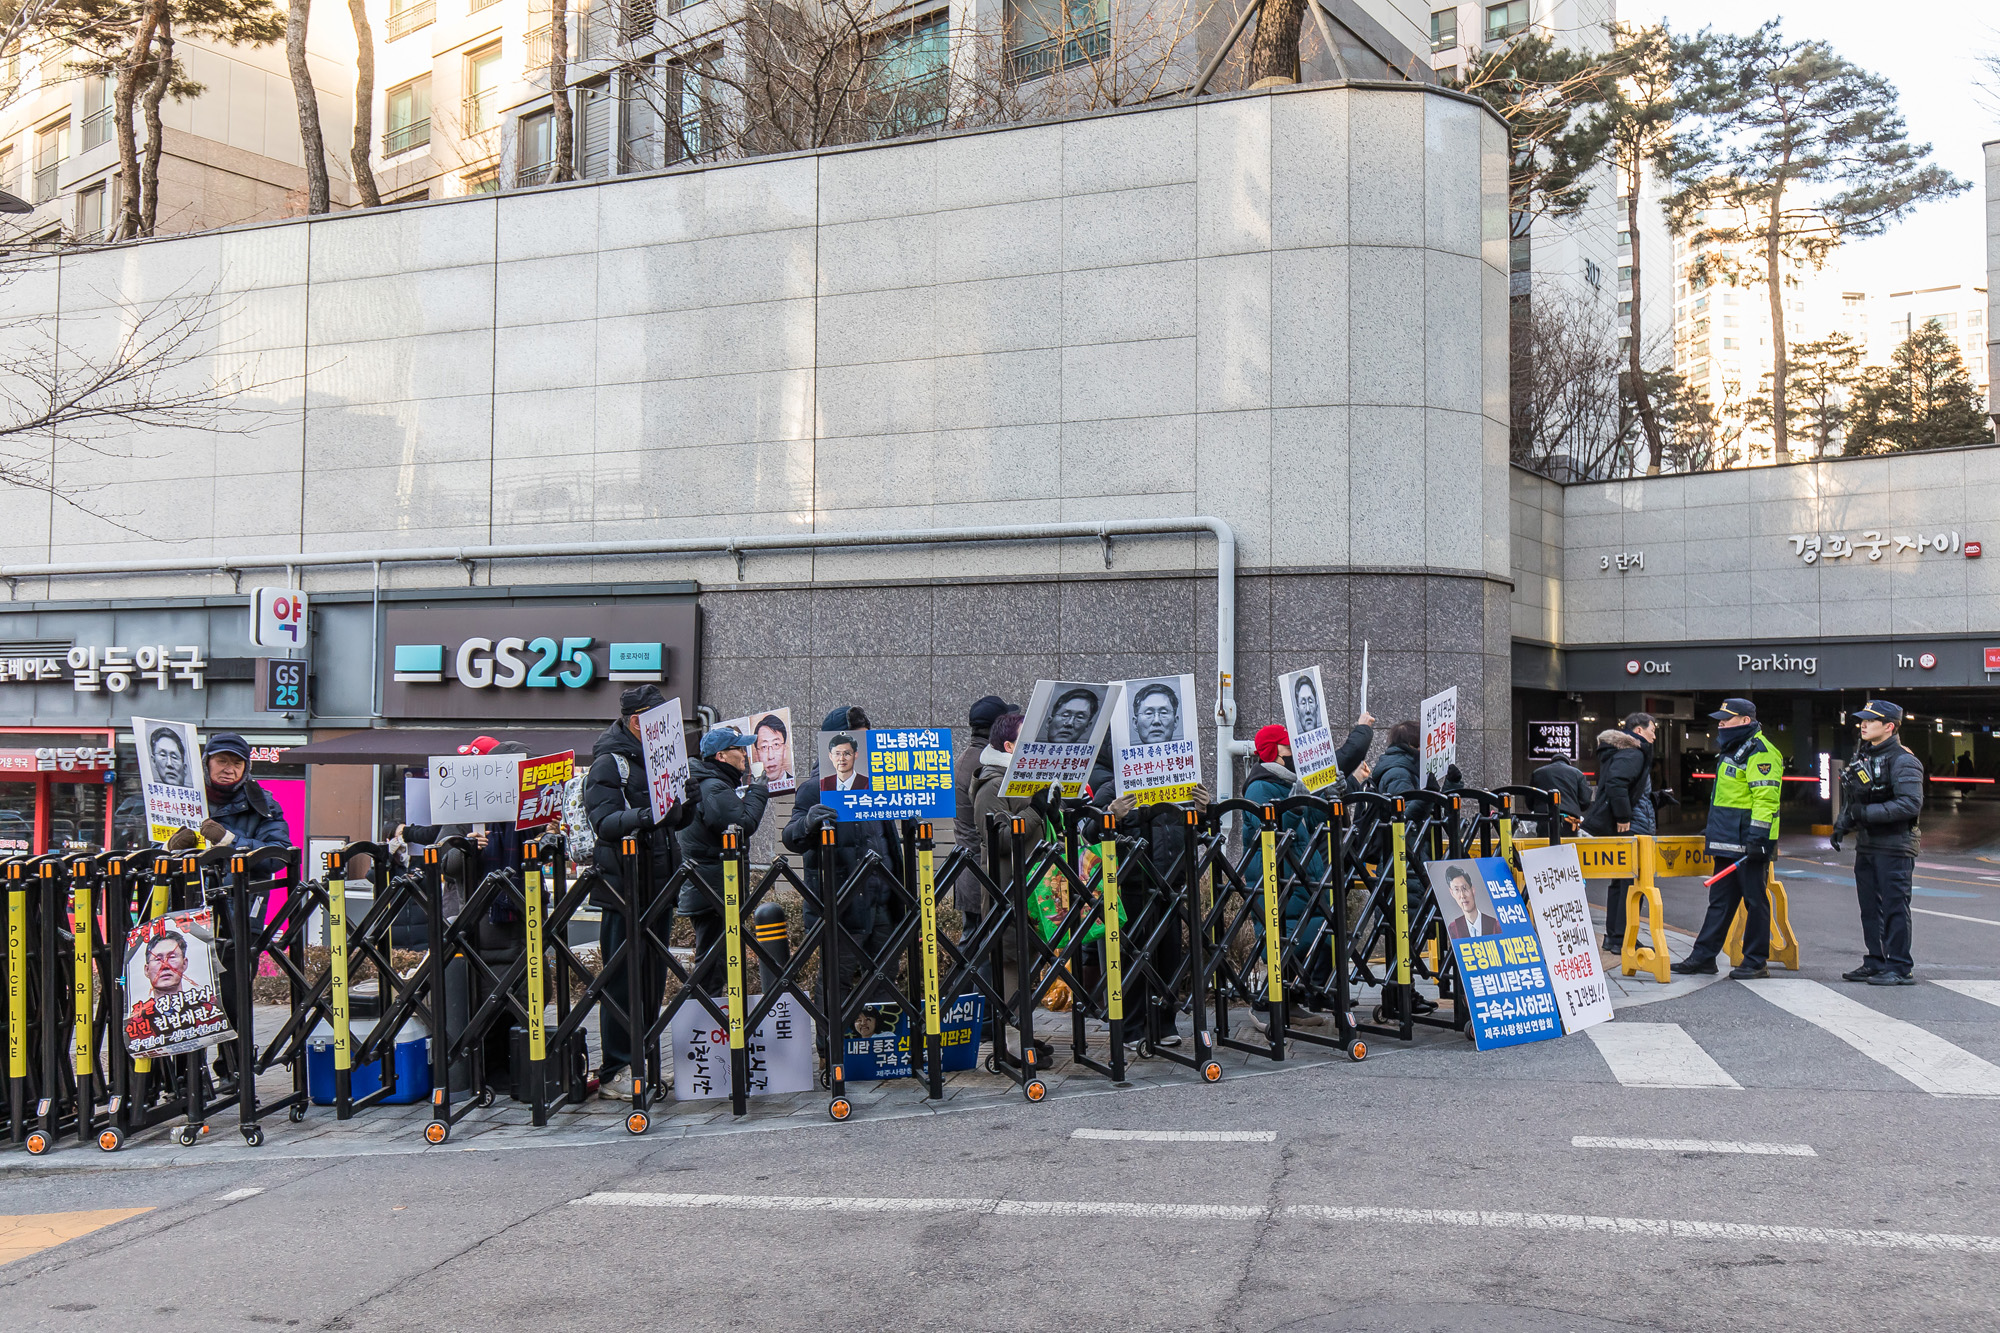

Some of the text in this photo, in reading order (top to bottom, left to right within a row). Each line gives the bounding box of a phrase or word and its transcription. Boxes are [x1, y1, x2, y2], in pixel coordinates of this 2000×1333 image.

[1584, 257, 1601, 290] 302
[1788, 530, 1960, 564] 경희궁자이
[1600, 551, 1645, 571] 3 단지
[273, 594, 302, 643] 약
[456, 637, 594, 689] GS25
[619, 652, 650, 661] 종로자이점
[1644, 660, 1671, 674] Out
[1737, 653, 1818, 675] Parking
[1897, 653, 1914, 668] In
[67, 644, 207, 692] 일등약국
[276, 664, 299, 685] GS
[276, 685, 299, 707] 25
[875, 731, 940, 749] 민노총하수인
[1539, 725, 1571, 736] 상가전용
[1022, 743, 1096, 756] 편파적 졸속 탄핵심리
[1121, 740, 1193, 761] 편파적 졸속 탄핵심리
[1547, 737, 1571, 747] 주차장
[35, 746, 117, 772] 일등약국
[250, 747, 290, 763] 소모성
[870, 750, 951, 773] 문형배 재판관
[521, 758, 574, 792] 탄핵무효
[871, 773, 953, 792] 불법내란주동
[439, 788, 518, 811] 사퇴해라
[843, 792, 936, 809] 구속수사하라!
[1133, 790, 1157, 804] 법회장
[1179, 785, 1196, 798] 다르
[855, 809, 922, 819] 제주사랑청년연합회
[1583, 850, 1627, 866] LINE
[1686, 849, 1715, 864] POLI
[1566, 865, 1580, 883] 사는
[1269, 862, 1278, 928] POLICE
[1486, 879, 1517, 900] 민노총
[1497, 903, 1528, 925] 하수인
[1542, 898, 1584, 929] 헌법재판관
[924, 884, 937, 1015] POLICE LINE
[1459, 935, 1541, 972] 문형배 재판관
[528, 905, 539, 1040] POLICE LINE
[725, 894, 742, 1030] 질서유지선
[10, 925, 19, 1058] POLICE LINE
[75, 922, 87, 1056] 질서유지선
[330, 914, 344, 1050] 질서유지선
[1469, 967, 1546, 998] 불법내란주동
[158, 986, 213, 1012] 정치판사
[1476, 992, 1555, 1024] 구속수사하라!
[125, 1005, 224, 1038] 인민 헌법재판소
[1484, 1017, 1554, 1040] 제주사랑청년연합회
[847, 1040, 870, 1055] 내란
[873, 1038, 895, 1054] 동조
[875, 1052, 898, 1068] 구속
